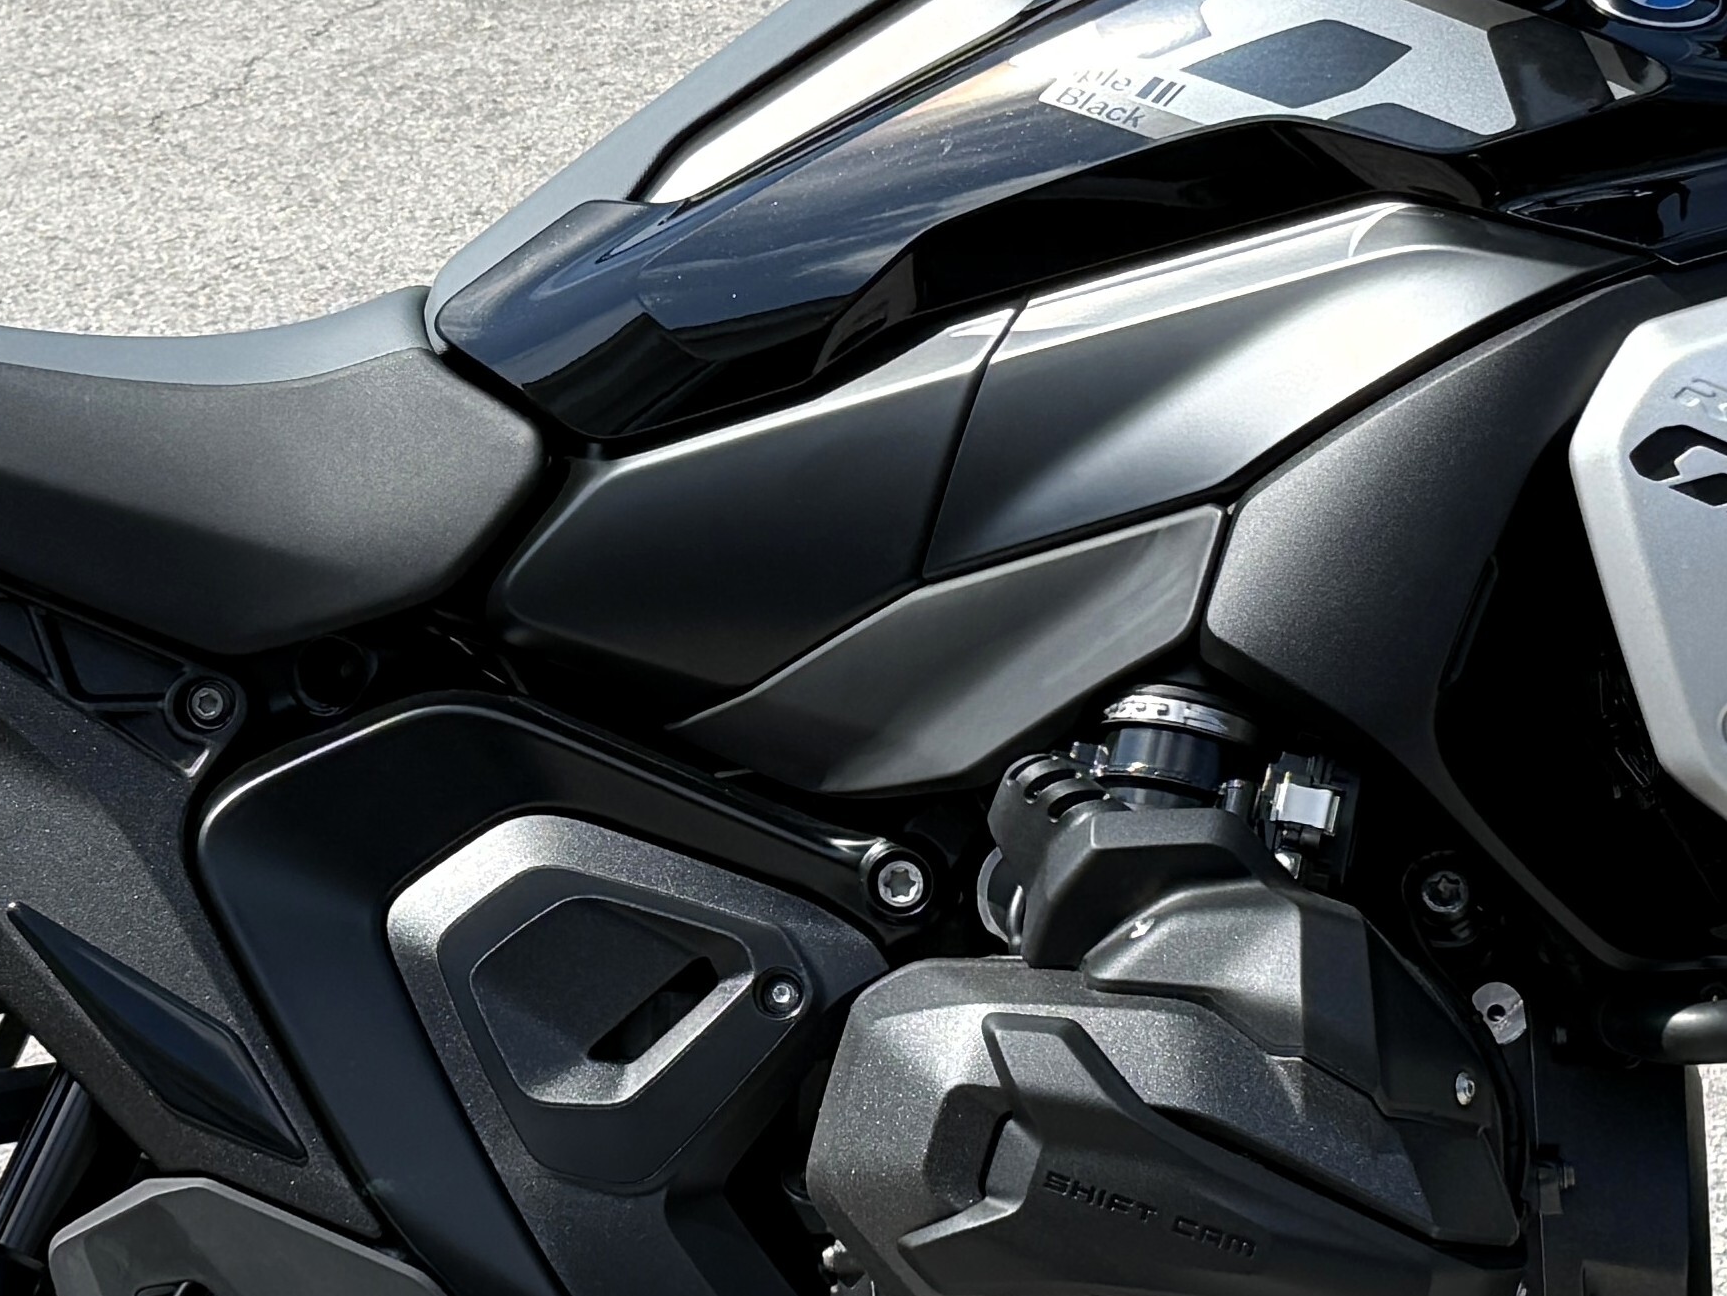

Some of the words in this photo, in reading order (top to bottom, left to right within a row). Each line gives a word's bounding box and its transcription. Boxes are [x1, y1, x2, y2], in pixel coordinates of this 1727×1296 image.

[1056, 86, 1146, 129] Black
[1041, 1169, 1159, 1225] SHIFT
[1172, 1215, 1258, 1260] CAM
